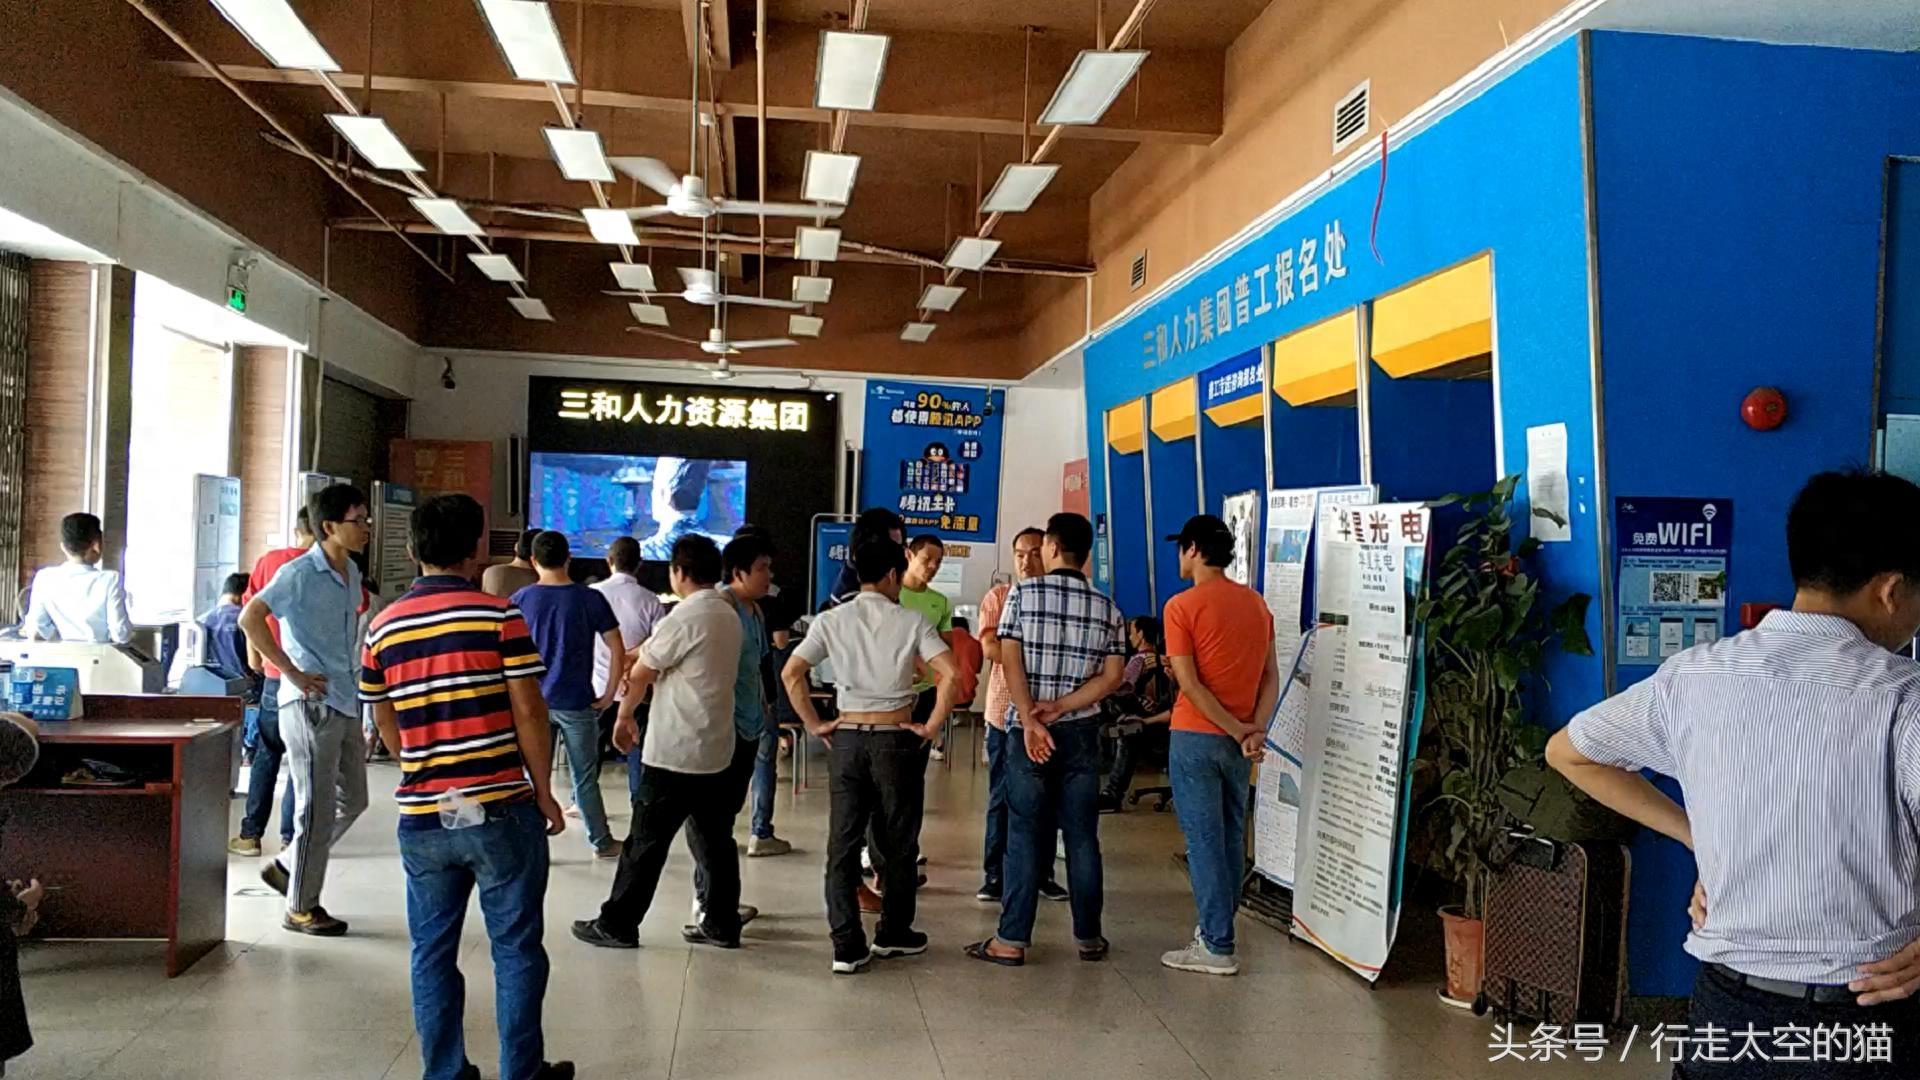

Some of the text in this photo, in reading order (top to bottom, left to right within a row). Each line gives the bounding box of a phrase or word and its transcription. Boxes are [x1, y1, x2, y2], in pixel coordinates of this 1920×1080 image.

[1143, 219, 1347, 369] 三和人力集团普工报名处
[558, 391, 808, 432] 三和人力资源集团
[1337, 509, 1424, 543] 华星光电
